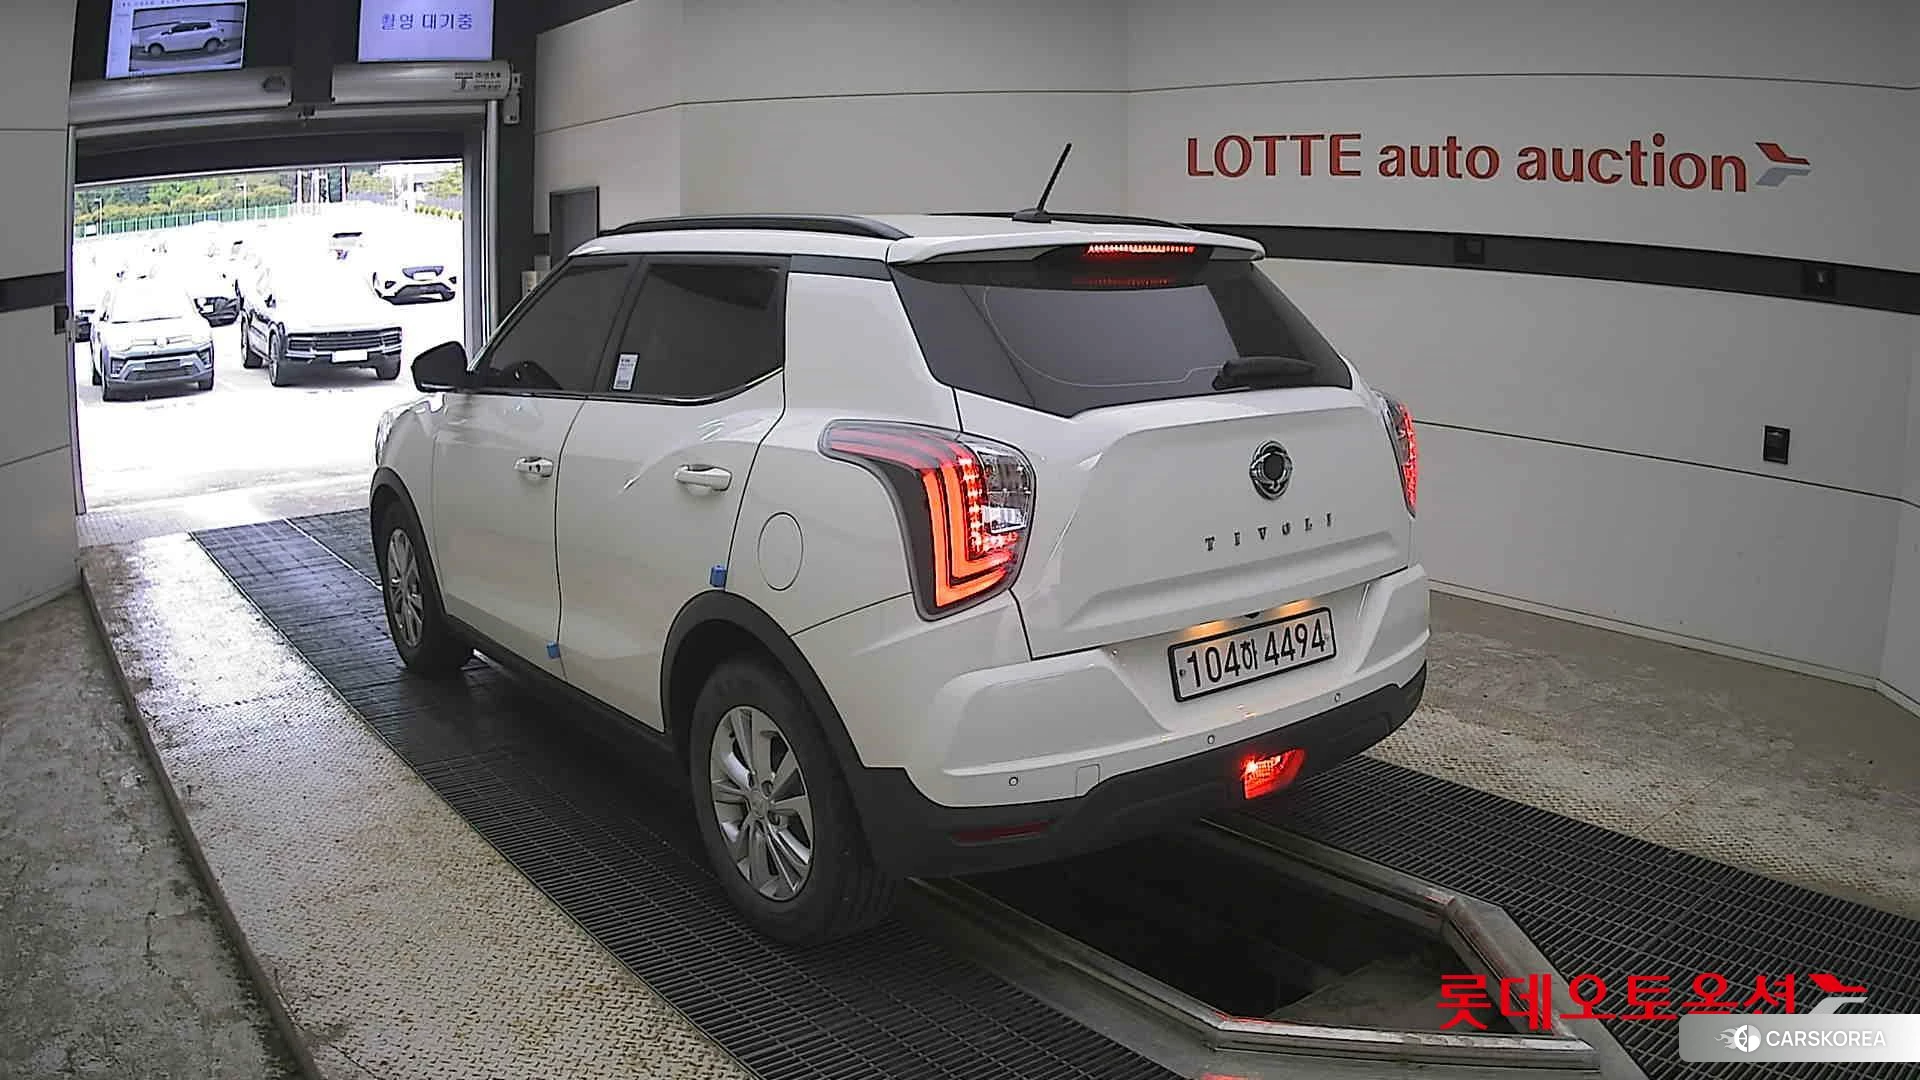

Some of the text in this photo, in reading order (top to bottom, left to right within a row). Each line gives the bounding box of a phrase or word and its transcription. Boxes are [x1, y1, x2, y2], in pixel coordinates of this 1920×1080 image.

[422, 13, 472, 30] 대기중
[1186, 133, 1748, 193] LOTTE auto auction
[1204, 512, 1334, 551] TIVOLI
[1186, 618, 1325, 688] 104하 4494
